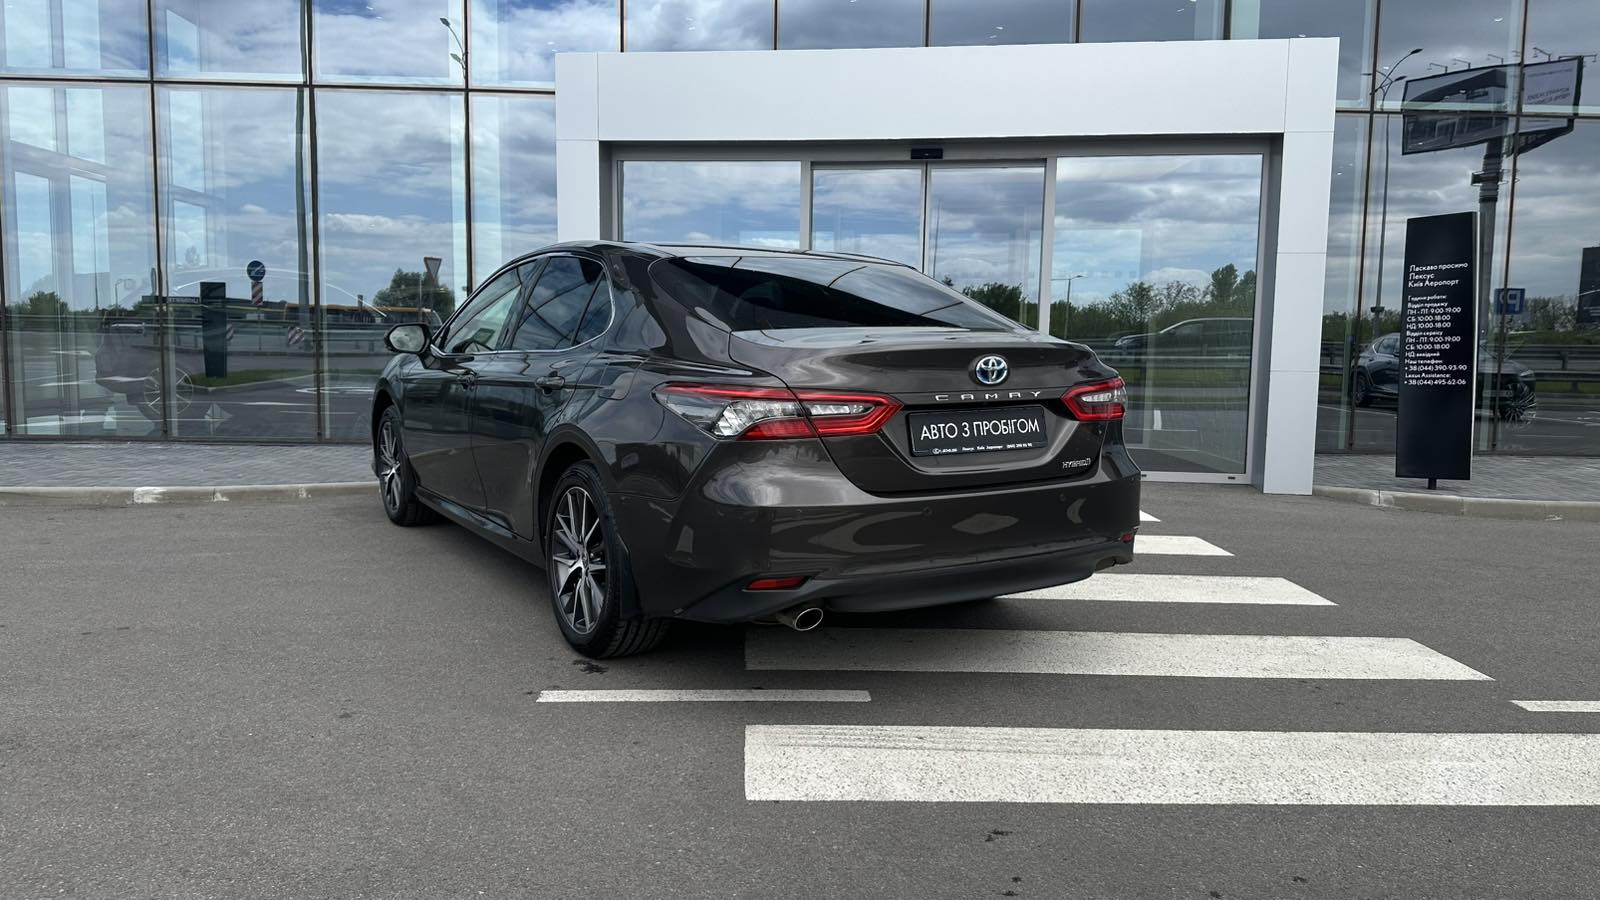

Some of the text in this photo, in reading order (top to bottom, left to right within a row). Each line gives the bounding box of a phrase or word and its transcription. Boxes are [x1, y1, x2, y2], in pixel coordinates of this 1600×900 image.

[935, 390, 1041, 401] CAMRY
[920, 418, 1040, 441] АВТО З ПРОБІГОМ
